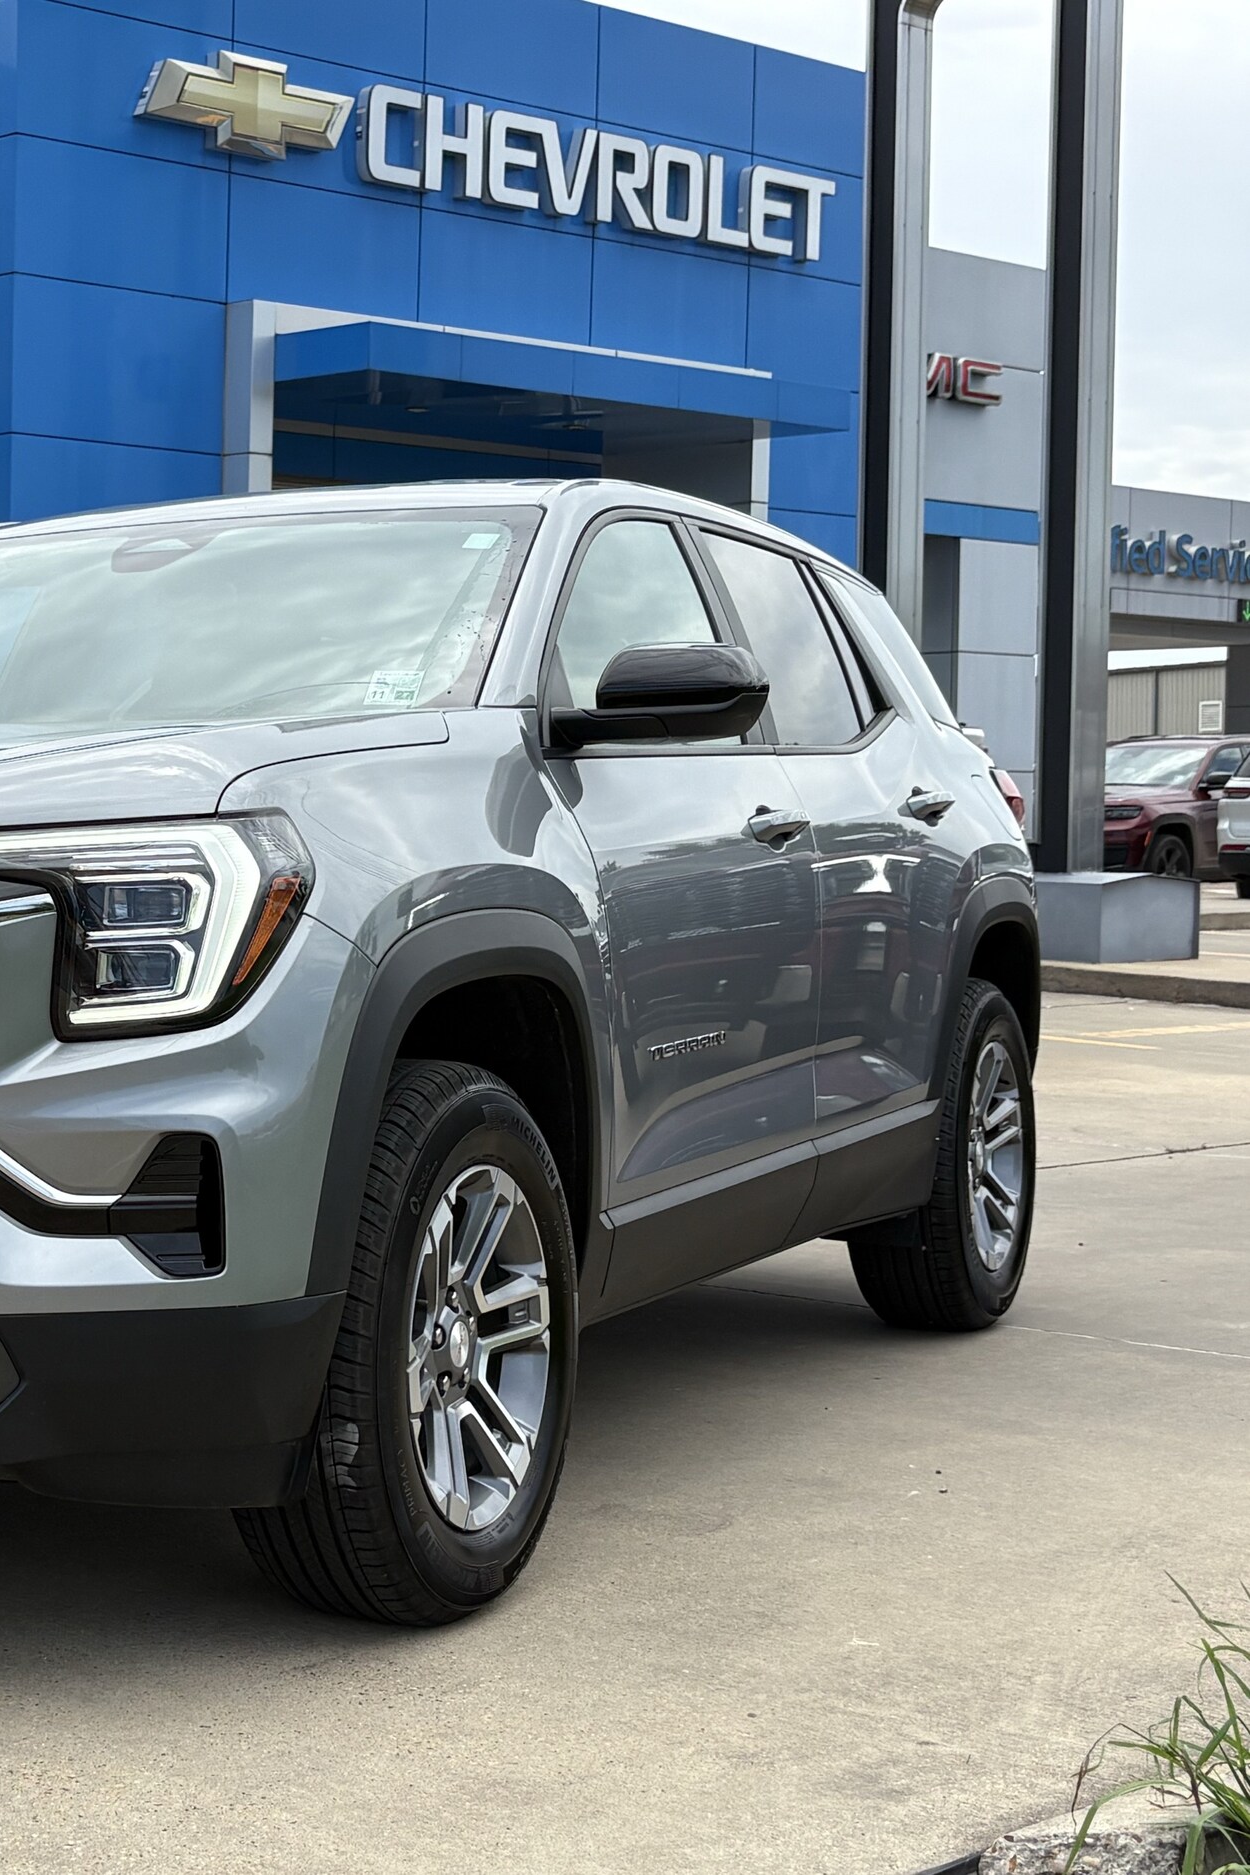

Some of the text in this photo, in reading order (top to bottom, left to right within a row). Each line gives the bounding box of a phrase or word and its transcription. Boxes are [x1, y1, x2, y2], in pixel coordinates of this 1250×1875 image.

[355, 84, 836, 263] CHEVROLET
[647, 1030, 726, 1060] TERRAIN
[510, 1114, 556, 1183] MICHELIN
